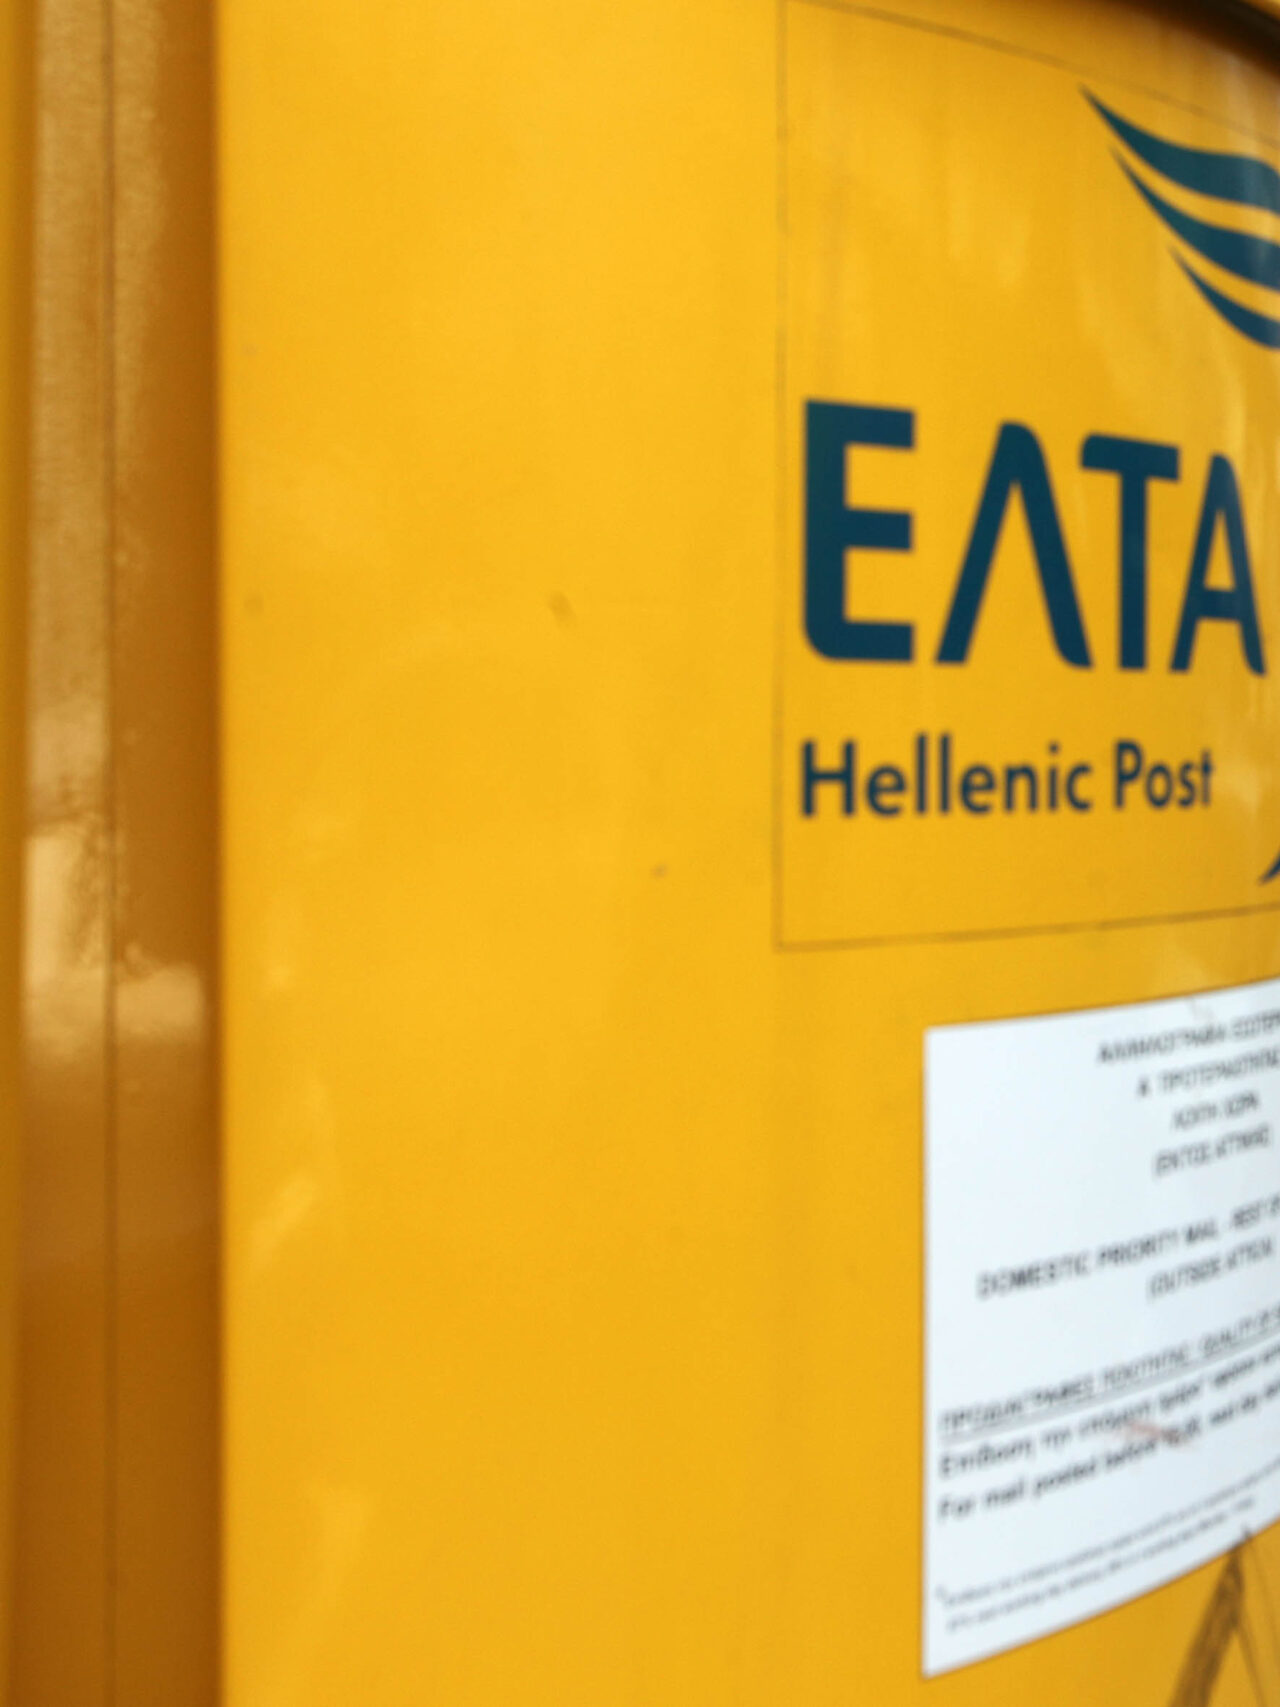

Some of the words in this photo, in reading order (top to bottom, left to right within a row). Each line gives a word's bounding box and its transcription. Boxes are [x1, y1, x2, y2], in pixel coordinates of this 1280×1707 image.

[803, 398, 1267, 677] ΕΛΤΑ
[801, 732, 1093, 818] Hellenic
[1114, 739, 1215, 811] Post
